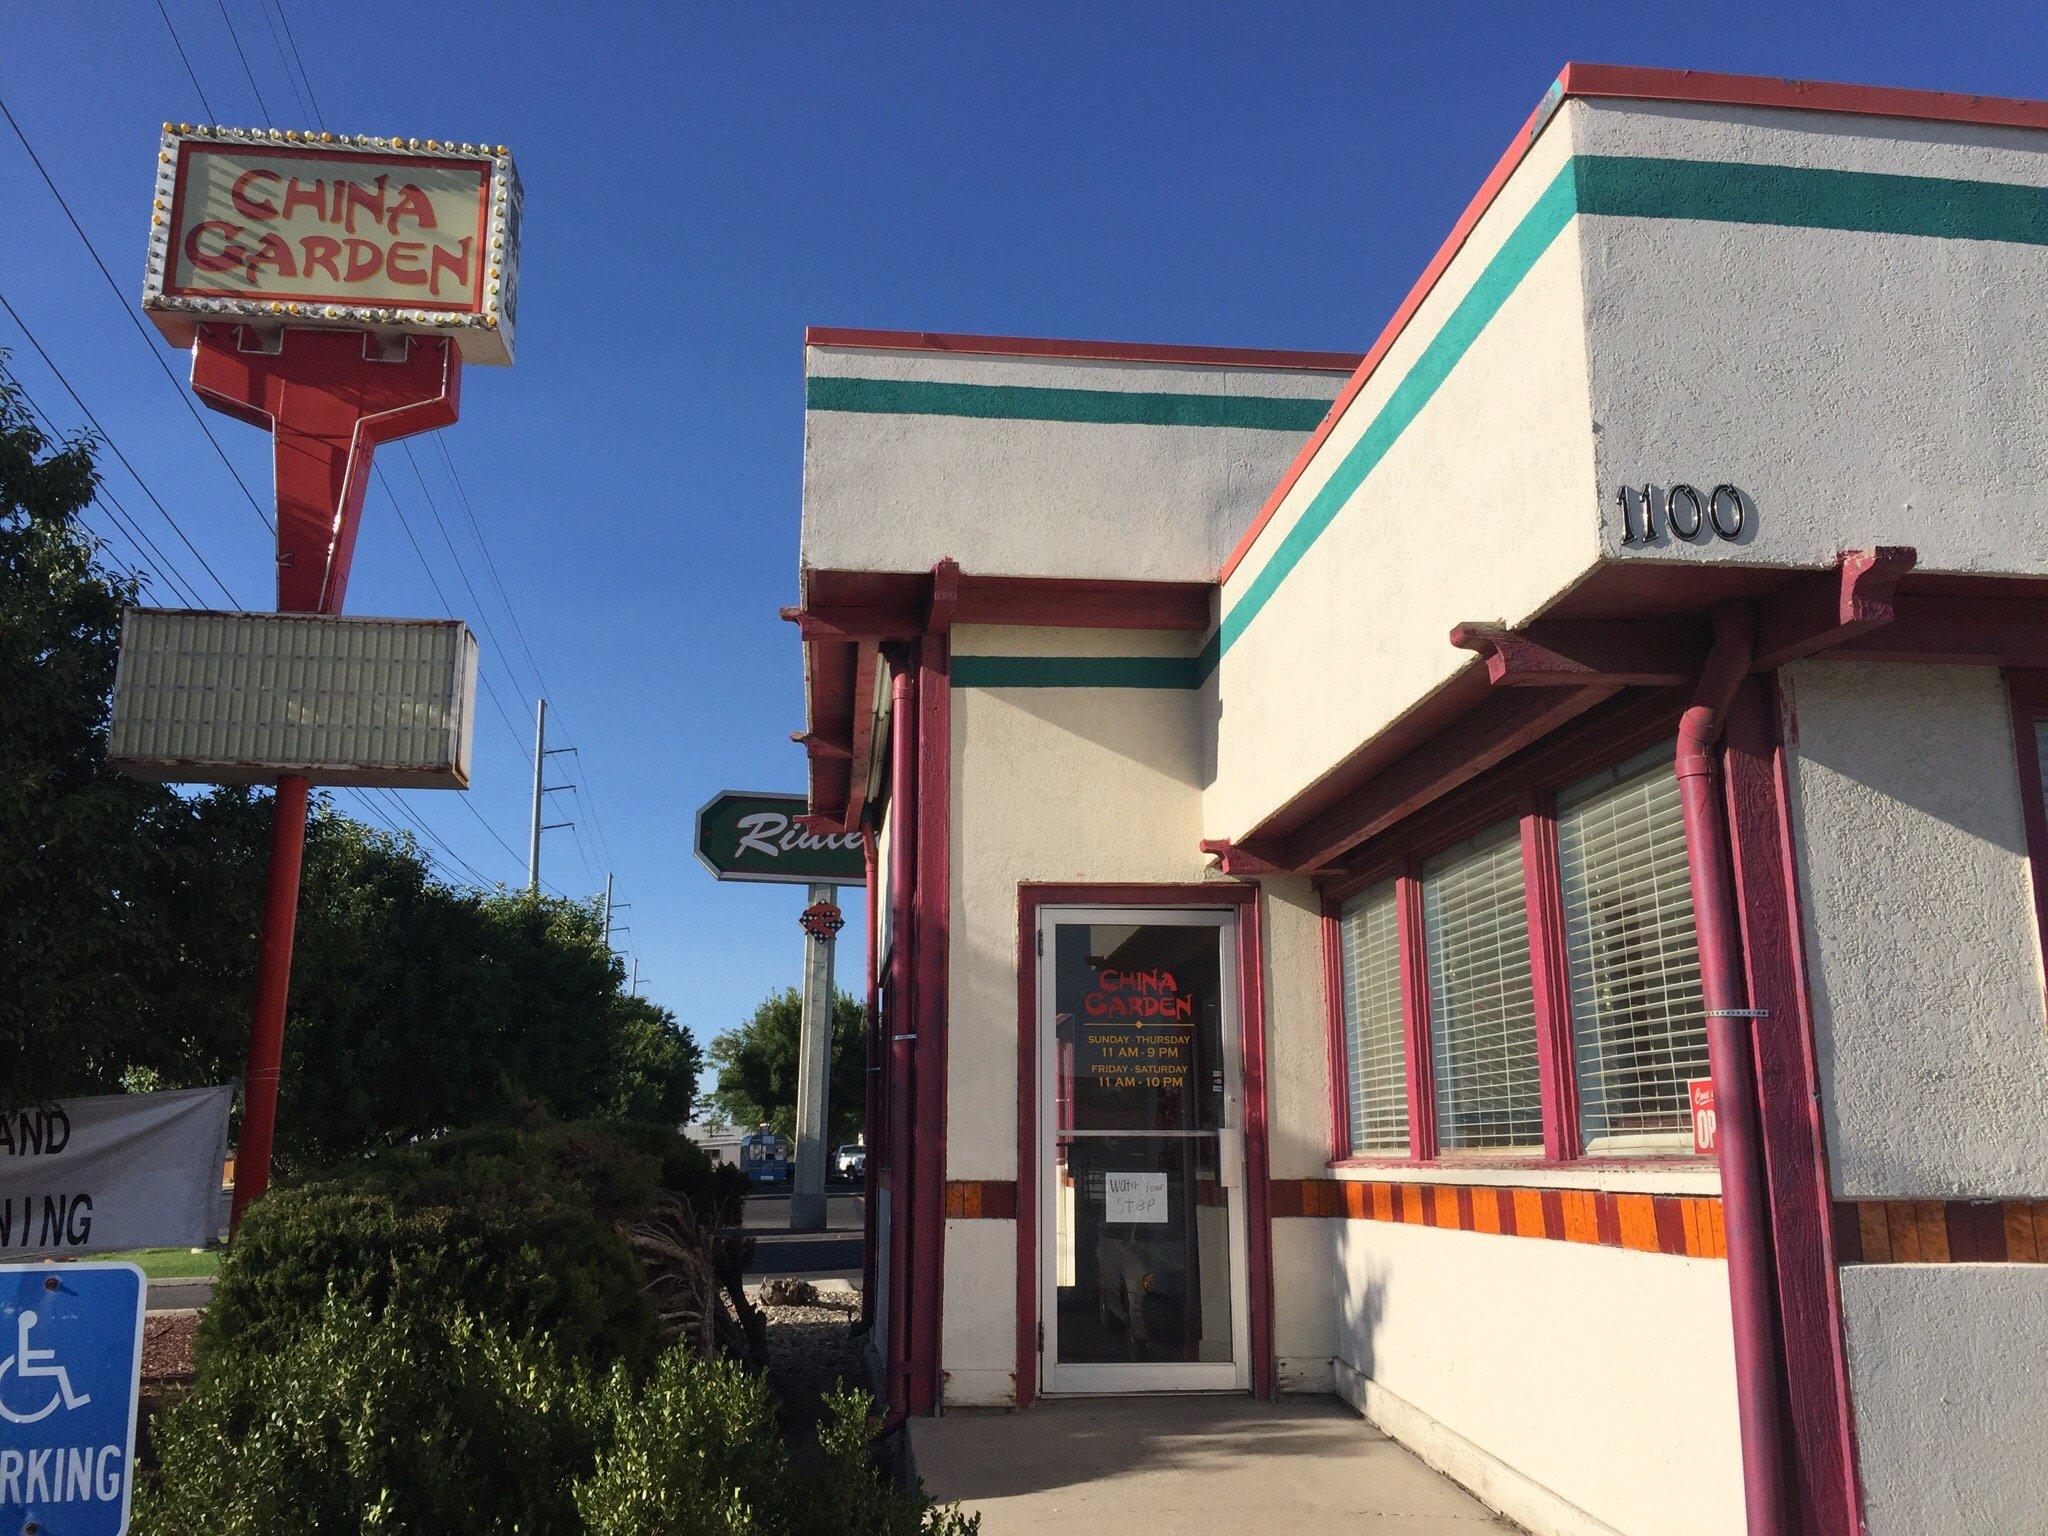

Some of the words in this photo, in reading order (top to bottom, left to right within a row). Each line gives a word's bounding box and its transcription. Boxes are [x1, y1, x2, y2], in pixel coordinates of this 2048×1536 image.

[231, 169, 437, 236] CHINA
[185, 220, 473, 297] GARDEN
[1616, 483, 1745, 546] 1100
[1098, 968, 1178, 996] CHINA
[1084, 992, 1192, 1021] GARDEN
[1088, 1035, 1130, 1044] SUNDAY
[1136, 1035, 1190, 1045] THURSDAY
[1102, 1047, 1113, 1058] 11
[1118, 1047, 1139, 1058] AM
[1147, 1047, 1156, 1058] 9
[1159, 1047, 1179, 1058] PM
[1091, 1065, 1128, 1074] FRIDAY
[1134, 1065, 1189, 1074] SATURDAY
[1100, 1076, 1110, 1087] 11
[1115, 1076, 1136, 1087] AM
[1146, 1076, 1160, 1087] 10
[1163, 1076, 1183, 1087] PM
[0, 1109, 70, 1155] AND
[0, 1445, 121, 1504] RKING
